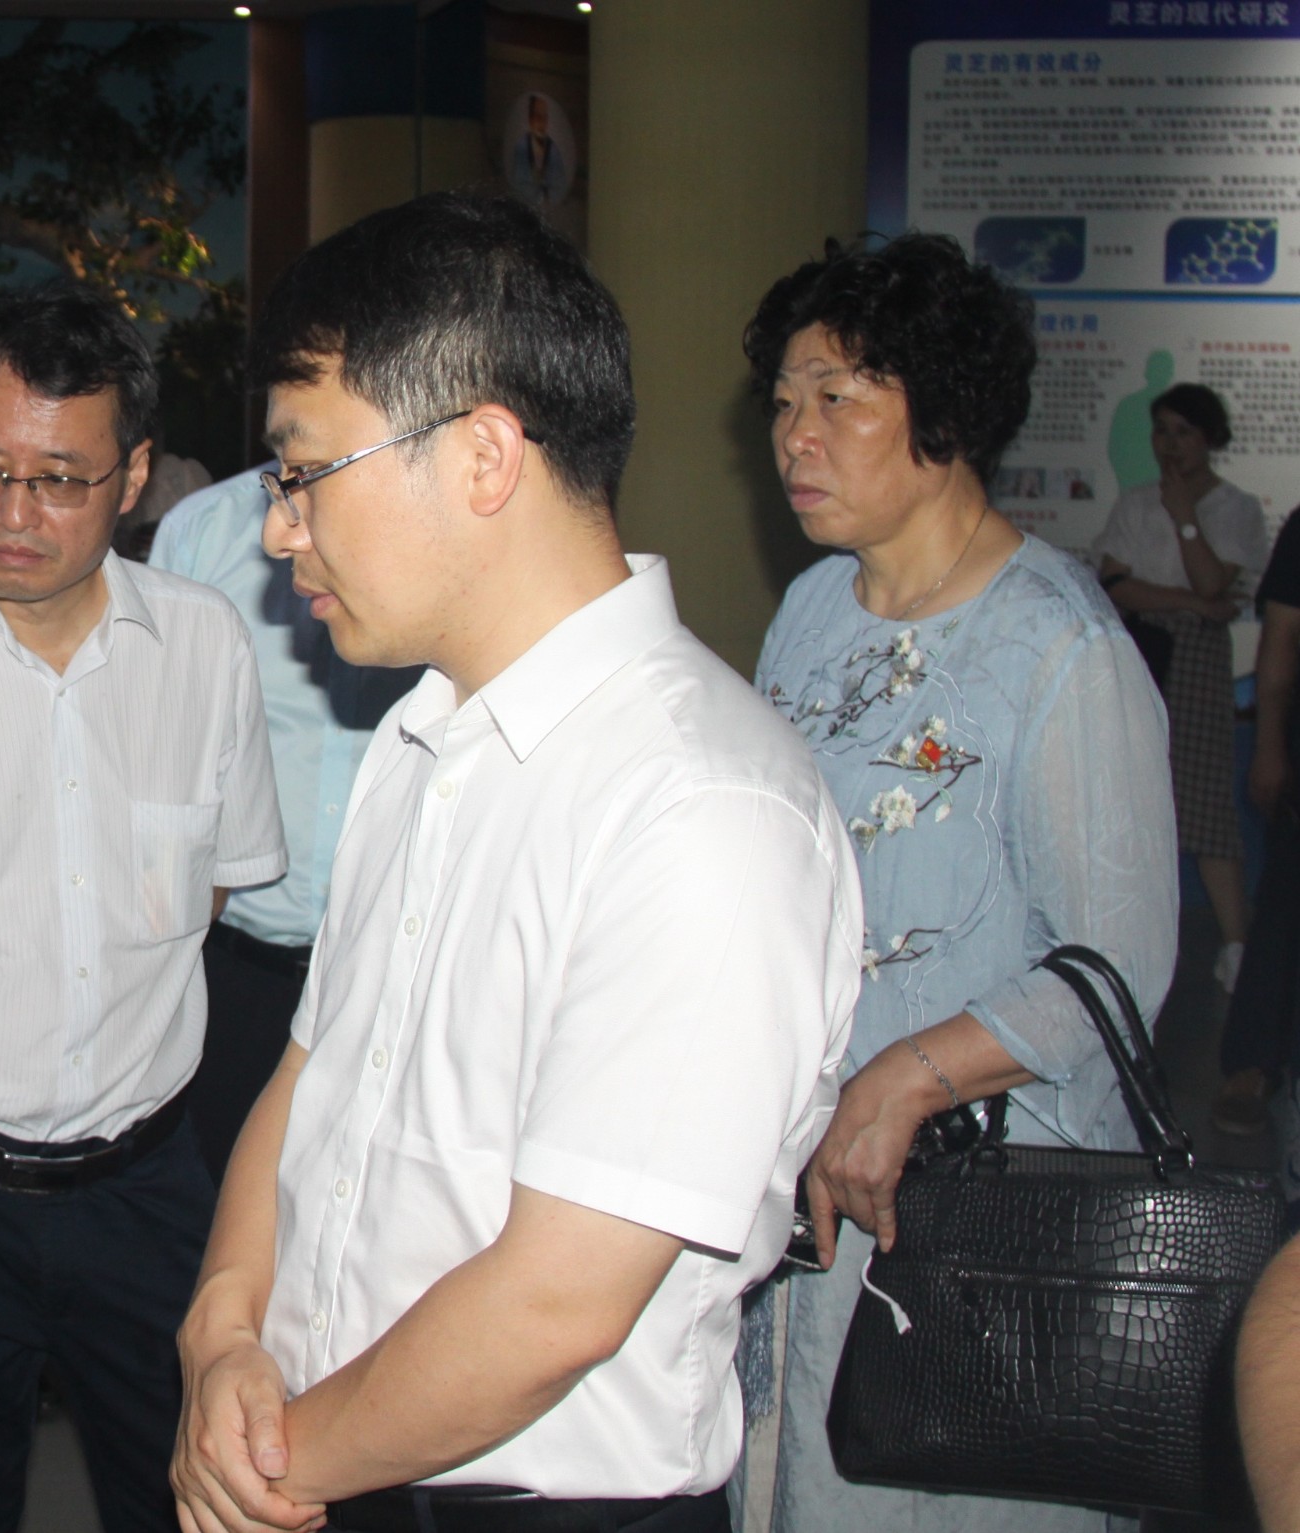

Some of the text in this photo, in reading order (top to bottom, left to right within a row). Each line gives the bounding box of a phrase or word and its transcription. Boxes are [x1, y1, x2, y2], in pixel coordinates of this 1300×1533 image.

[1108, 2, 1289, 27] 灵芝的现代研究
[945, 52, 1102, 75] 灵芝的有效成分
